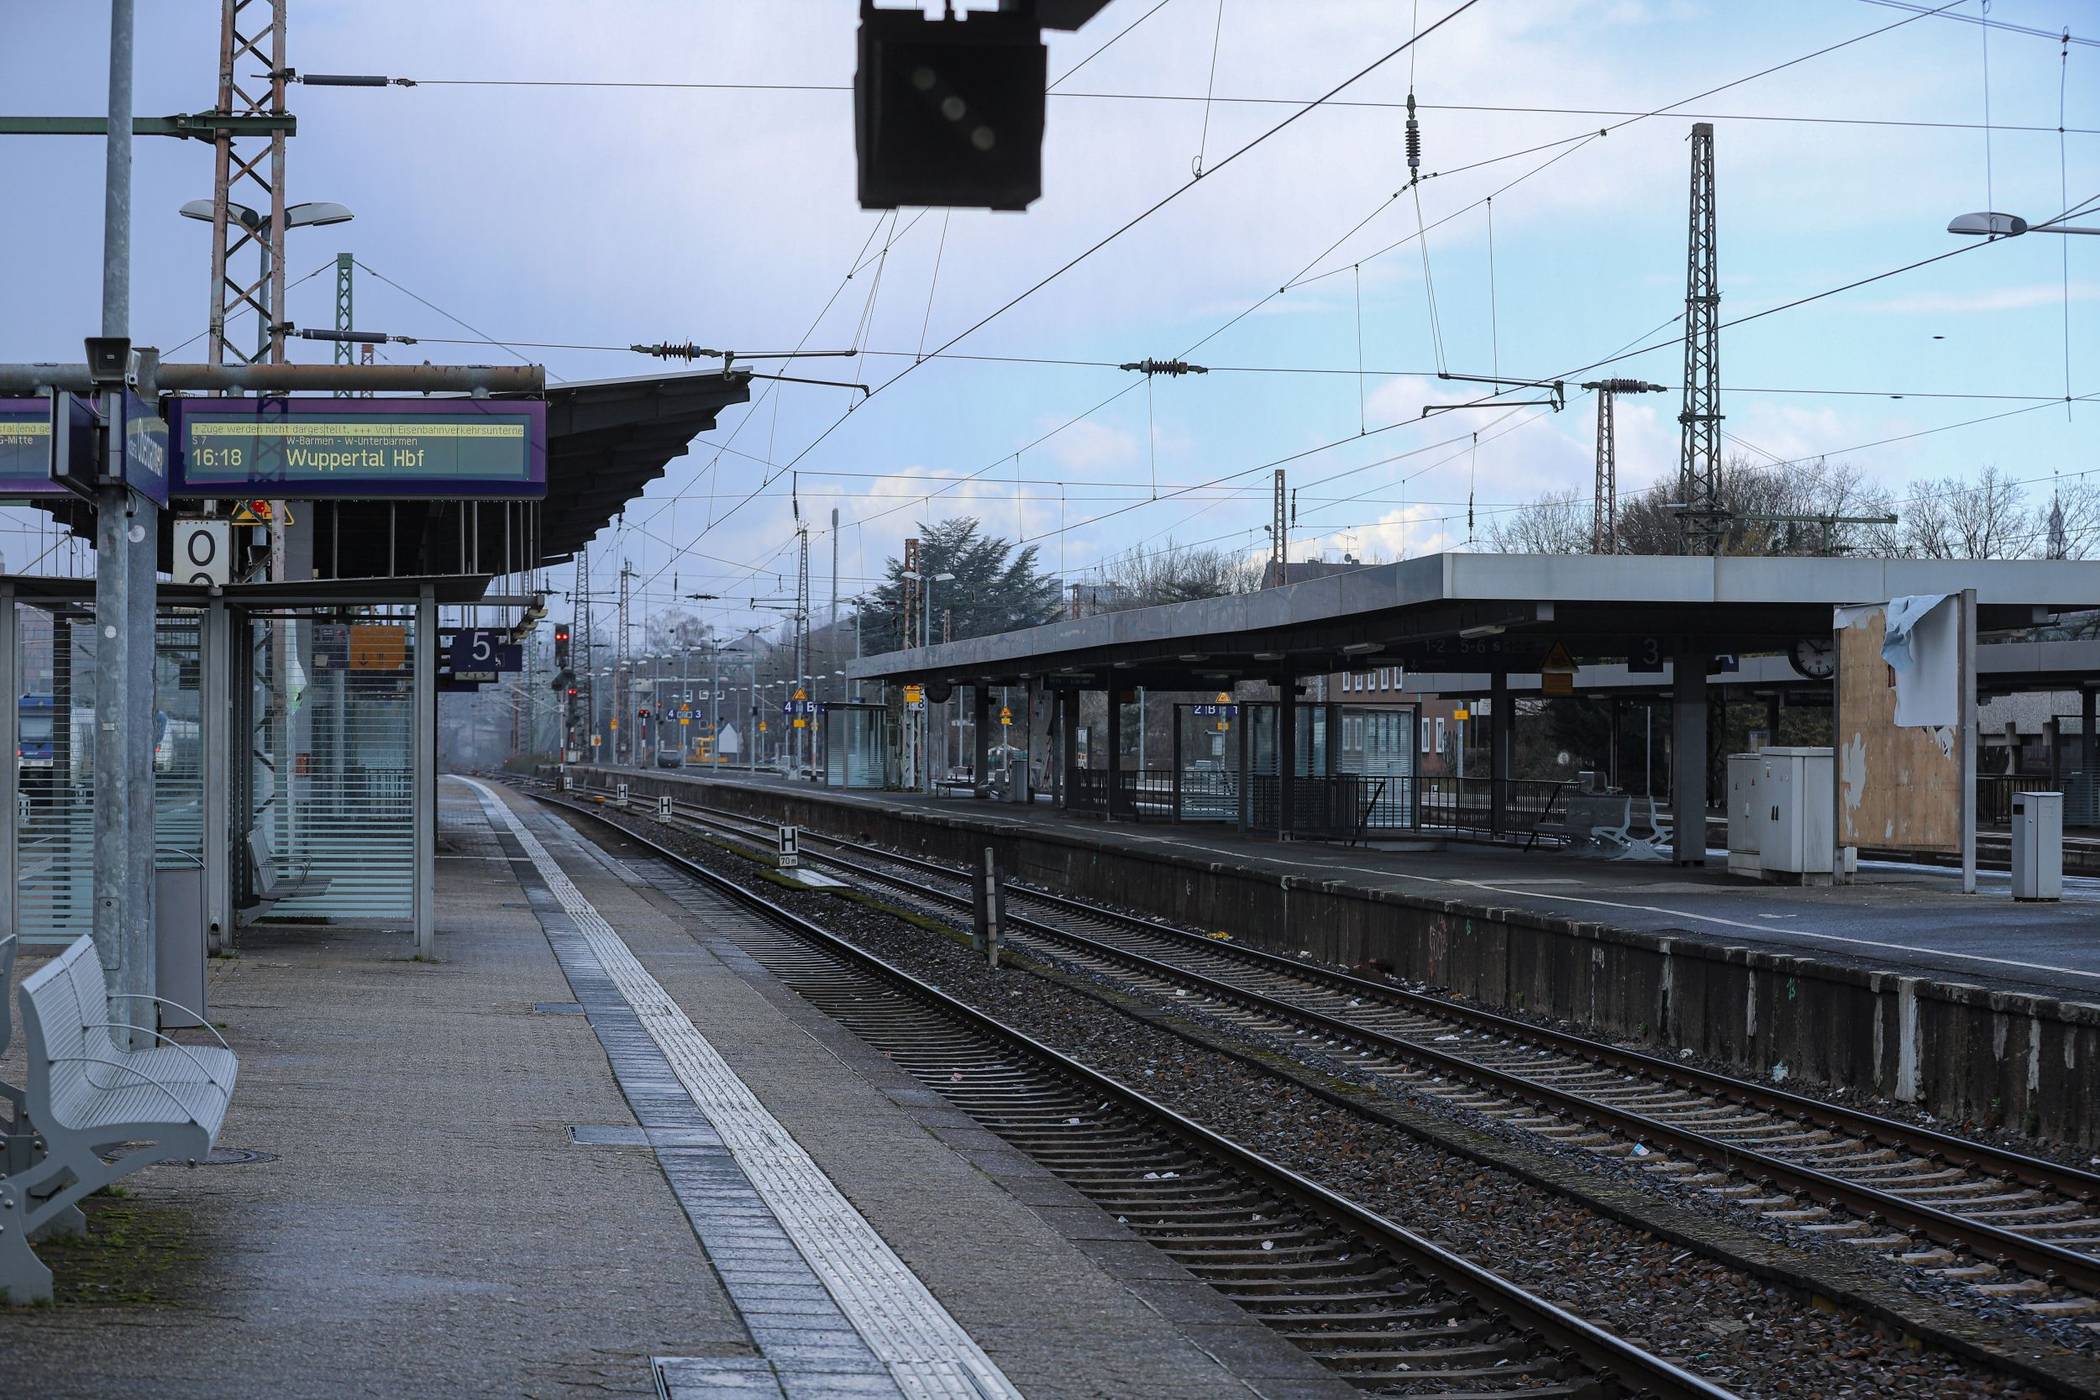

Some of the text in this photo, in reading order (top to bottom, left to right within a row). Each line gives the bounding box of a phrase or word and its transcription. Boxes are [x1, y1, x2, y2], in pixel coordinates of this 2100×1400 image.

[192, 436, 207, 445] S 7
[286, 436, 334, 445] W-Barmen
[344, 436, 418, 446] W-Unterbarmen
[192, 448, 425, 472] 16:18 Wuppertal Hbf
[472, 631, 491, 661] 5
[1642, 638, 1660, 665] 3
[784, 701, 792, 712] 4
[1194, 705, 1202, 715] 2
[695, 710, 702, 719] 3
[618, 785, 627, 798] H
[660, 797, 671, 814] H
[780, 828, 797, 852] H
